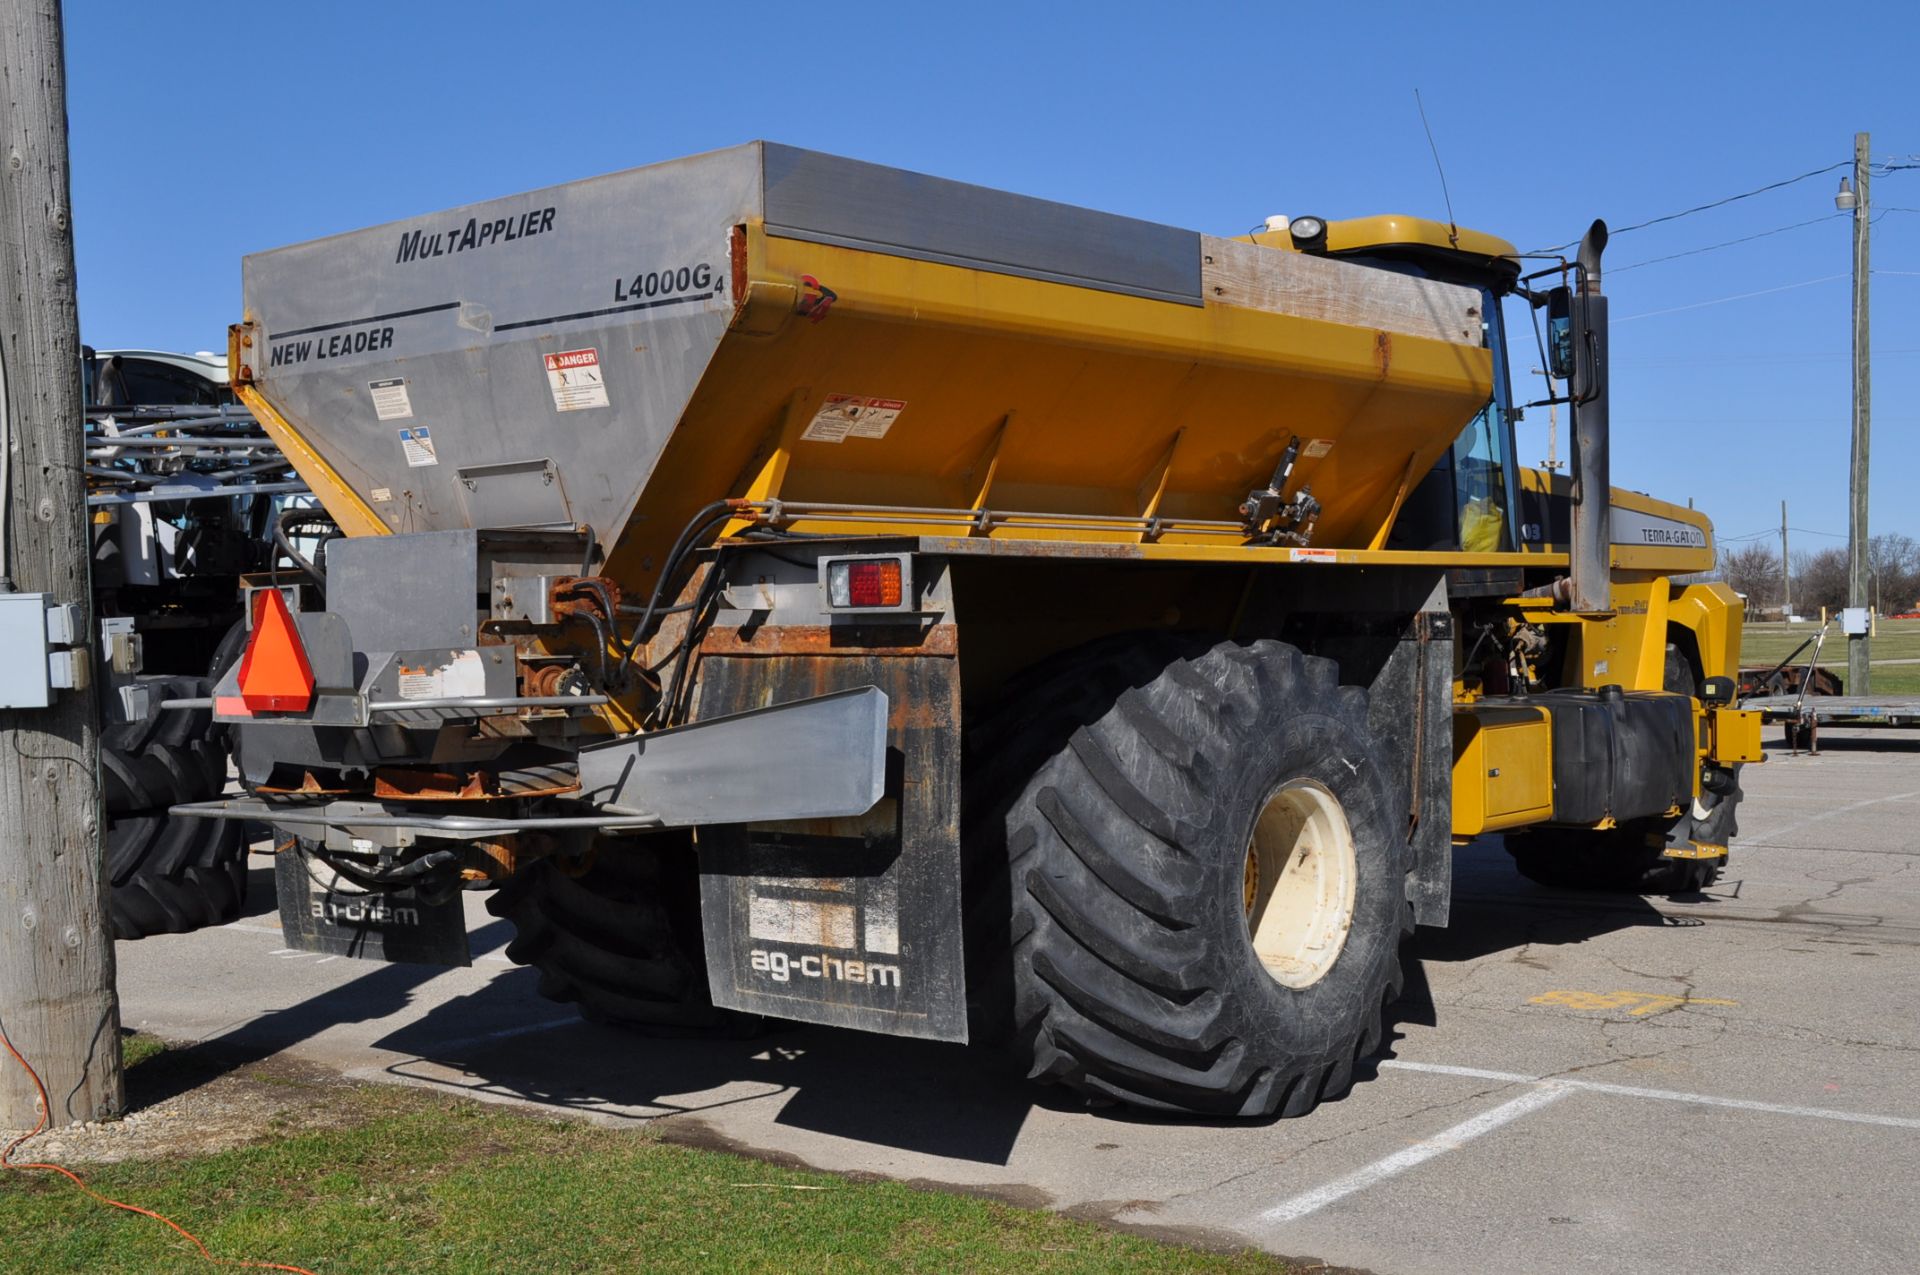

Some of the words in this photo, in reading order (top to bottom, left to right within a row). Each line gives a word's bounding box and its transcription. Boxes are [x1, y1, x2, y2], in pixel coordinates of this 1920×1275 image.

[271, 340, 312, 367] NEW
[317, 327, 394, 359] LEADER
[558, 353, 596, 367] DANGER
[750, 949, 901, 988] ag-chem
